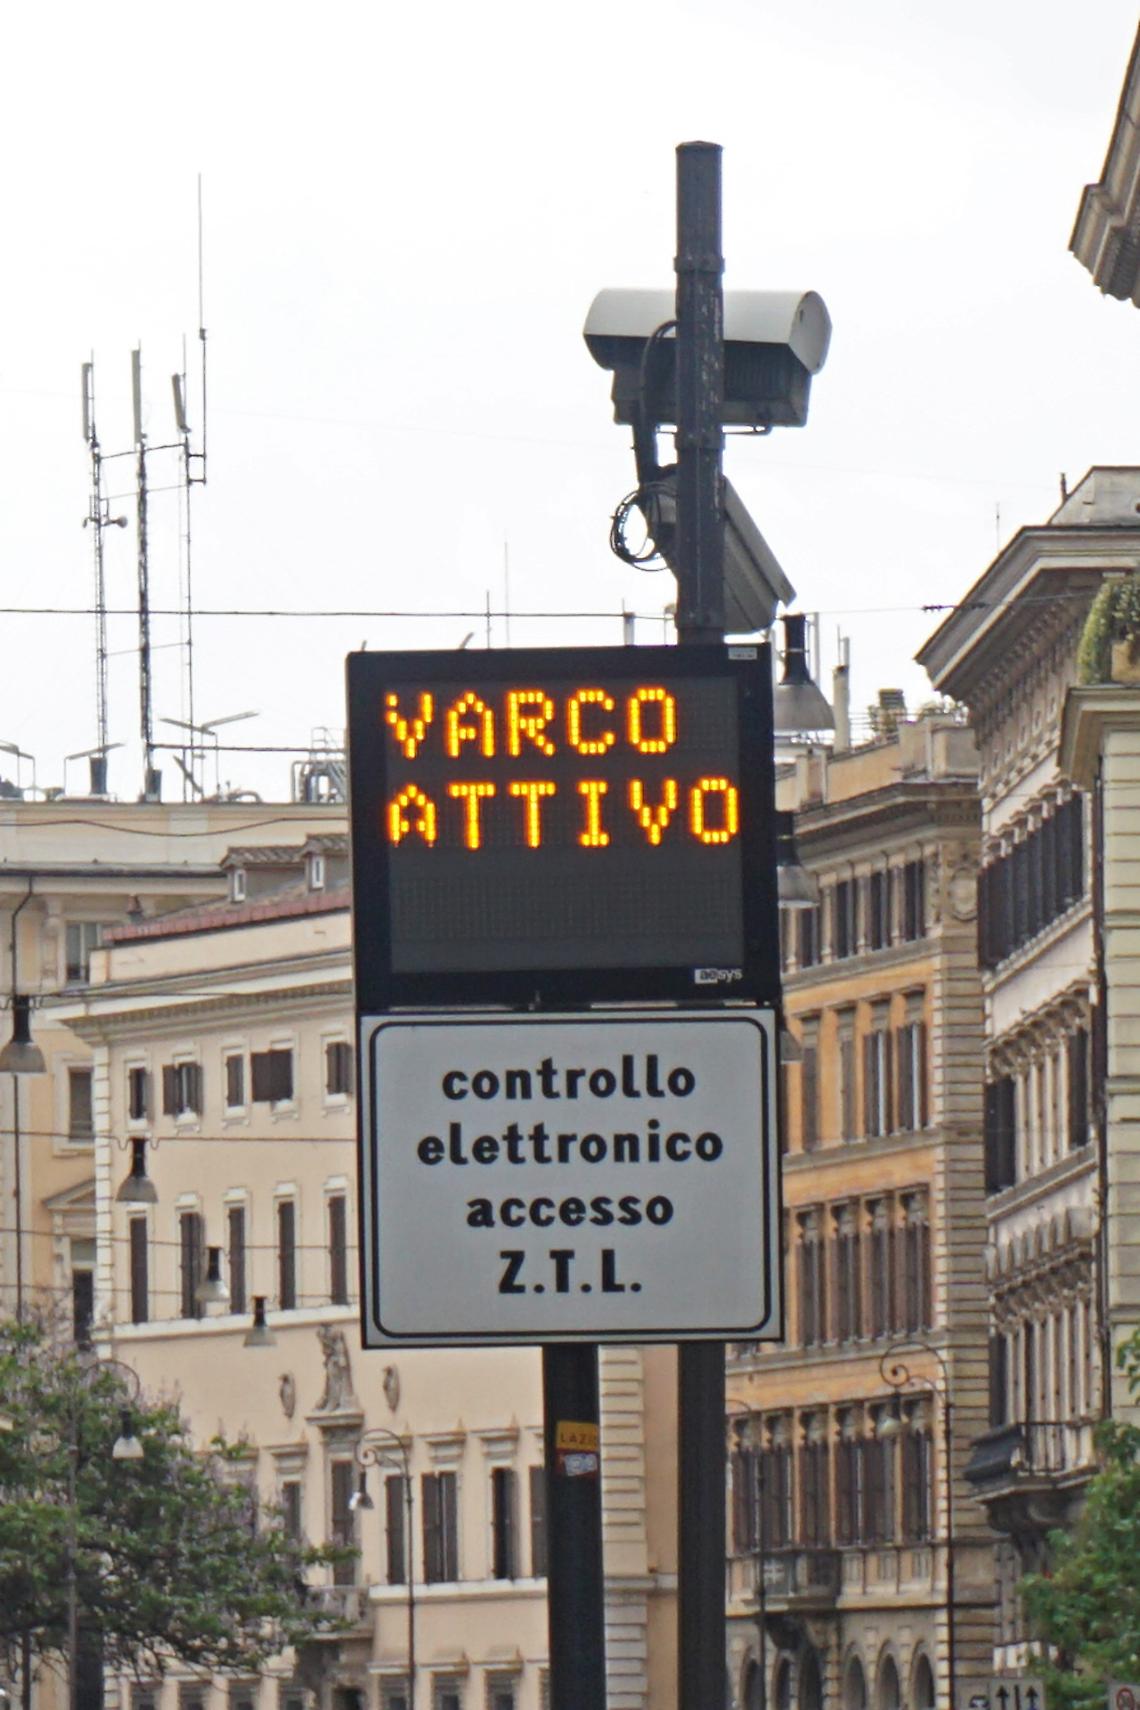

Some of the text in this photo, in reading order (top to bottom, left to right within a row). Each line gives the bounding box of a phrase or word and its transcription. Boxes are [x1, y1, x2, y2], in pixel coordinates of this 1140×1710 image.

[383, 685, 678, 760] VARCO
[386, 775, 741, 850] ATTIVO
[441, 1054, 697, 1101] controllo
[416, 1118, 724, 1166] elettronico
[466, 1194, 675, 1229] accesso
[497, 1248, 643, 1295] Z.T.L.
